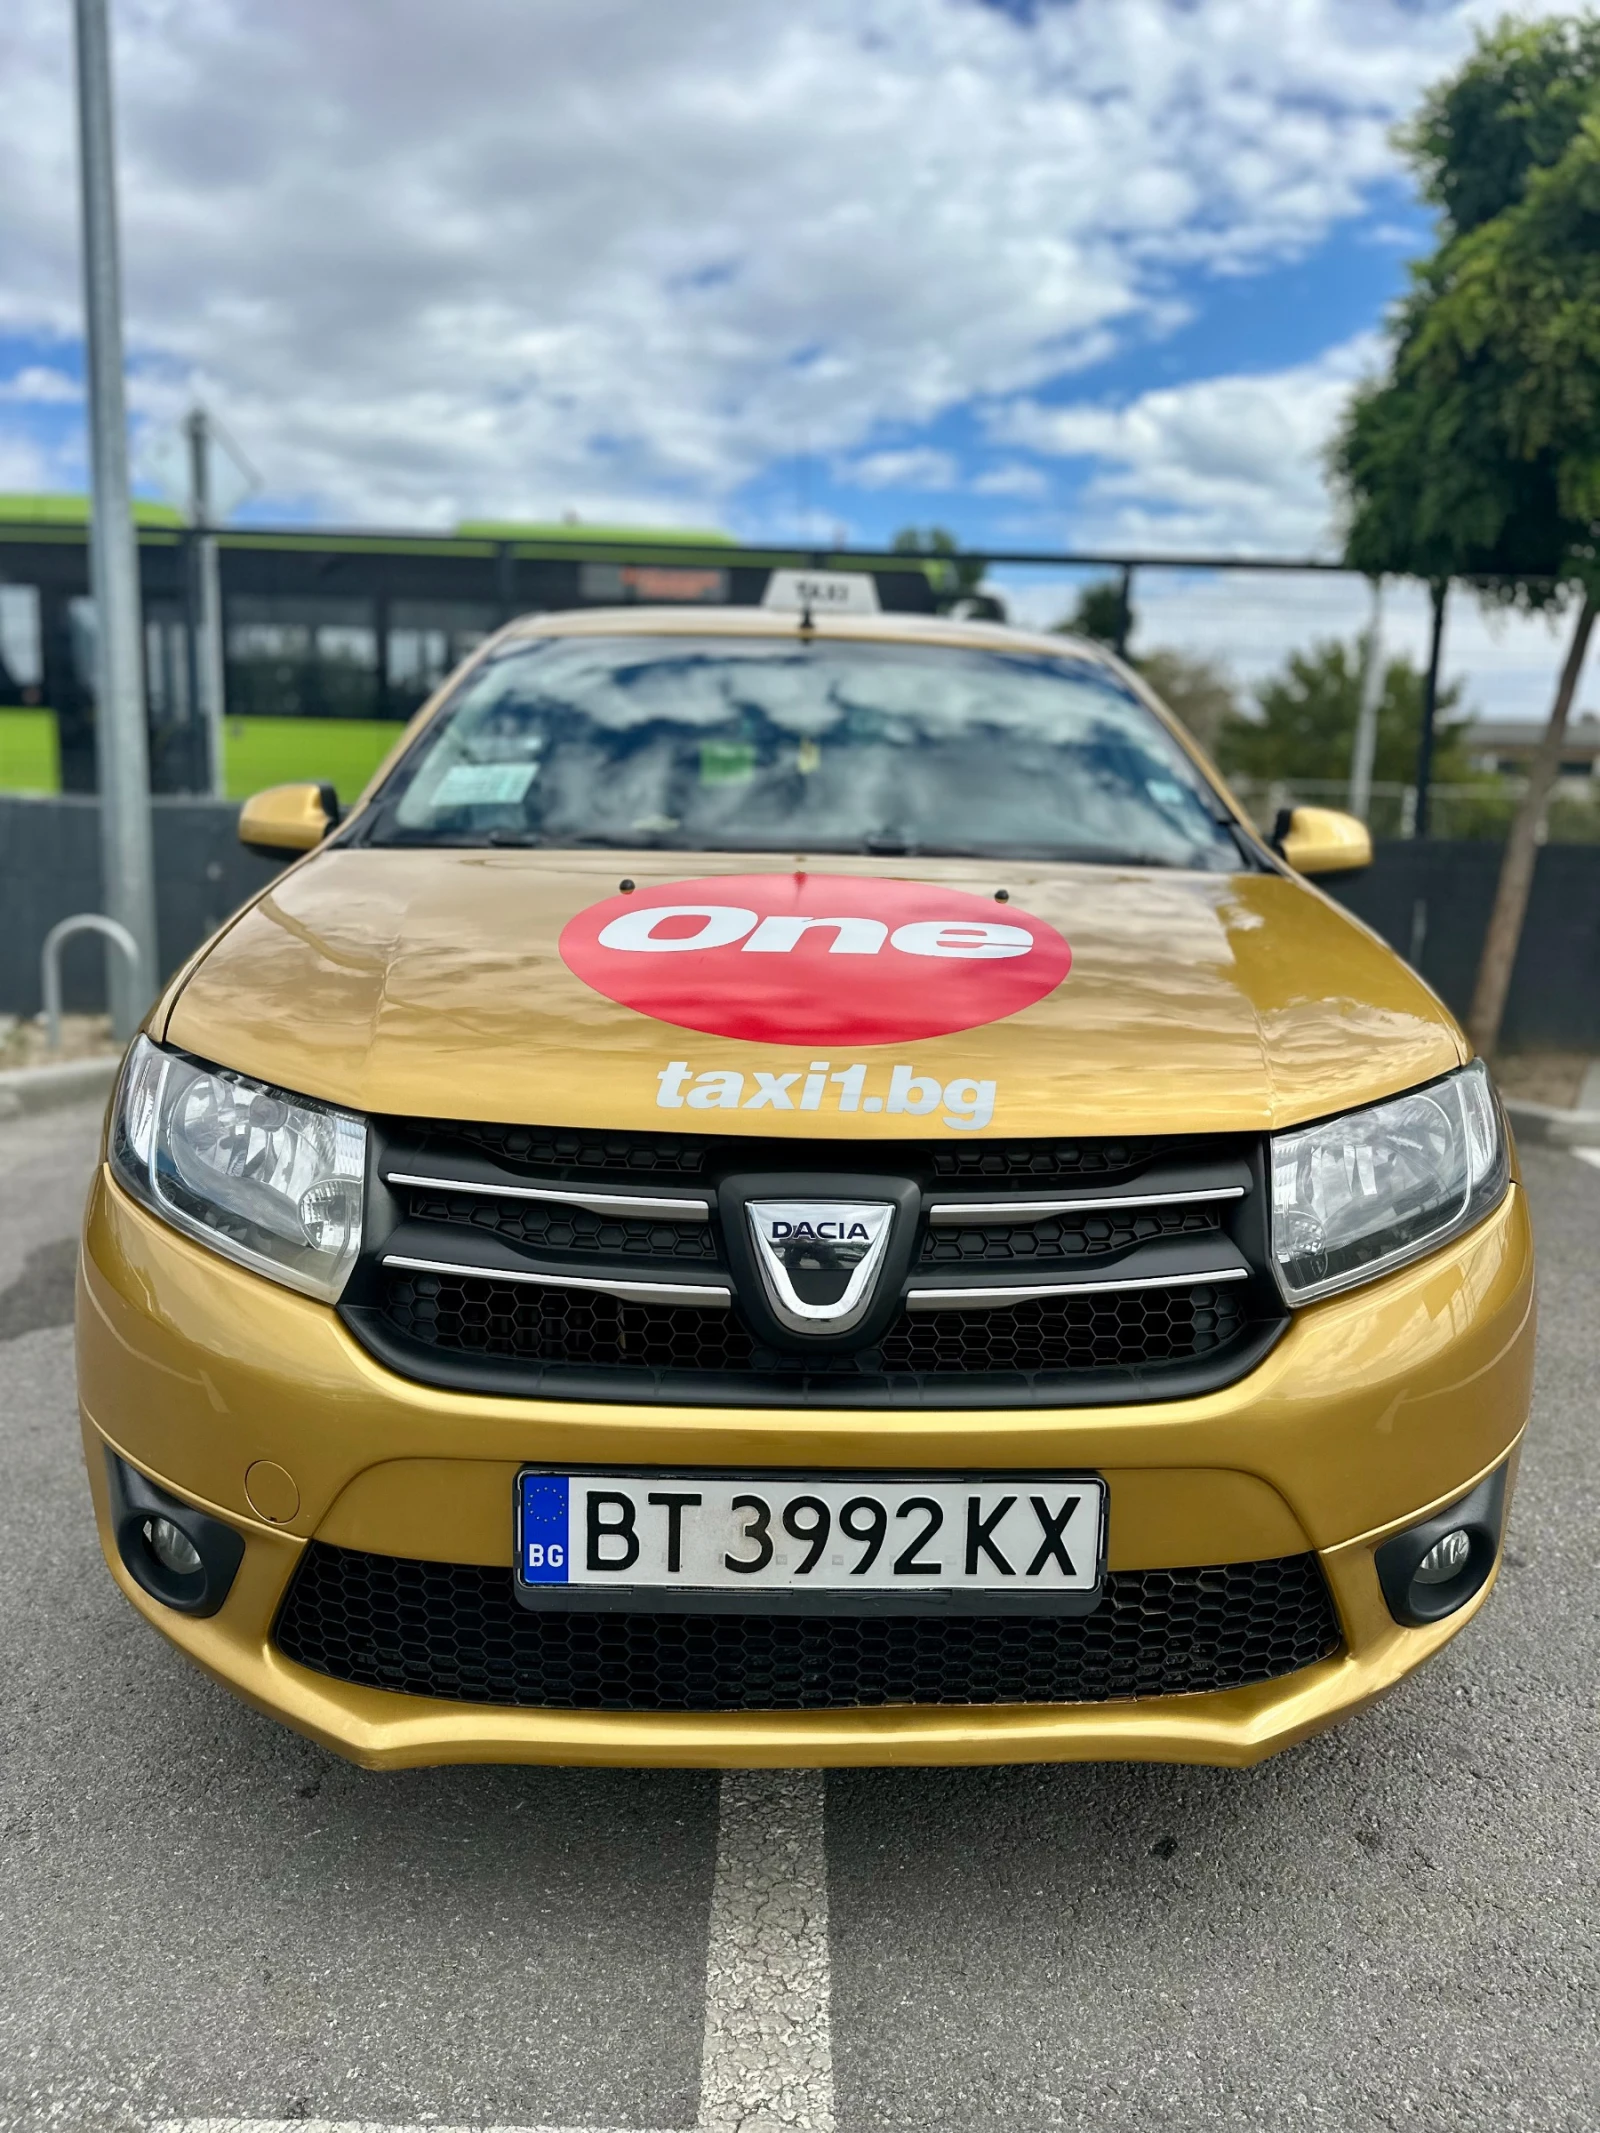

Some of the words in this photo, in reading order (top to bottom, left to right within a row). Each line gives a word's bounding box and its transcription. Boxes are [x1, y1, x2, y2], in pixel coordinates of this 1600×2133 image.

[598, 905, 1034, 959] One
[655, 1061, 998, 1131] taxi1.bg
[772, 1221, 869, 1240] DACIA
[528, 1543, 564, 1568] BG
[586, 1490, 702, 1573] BT
[724, 1495, 944, 1576] 3992
[964, 1496, 1082, 1576] KX
